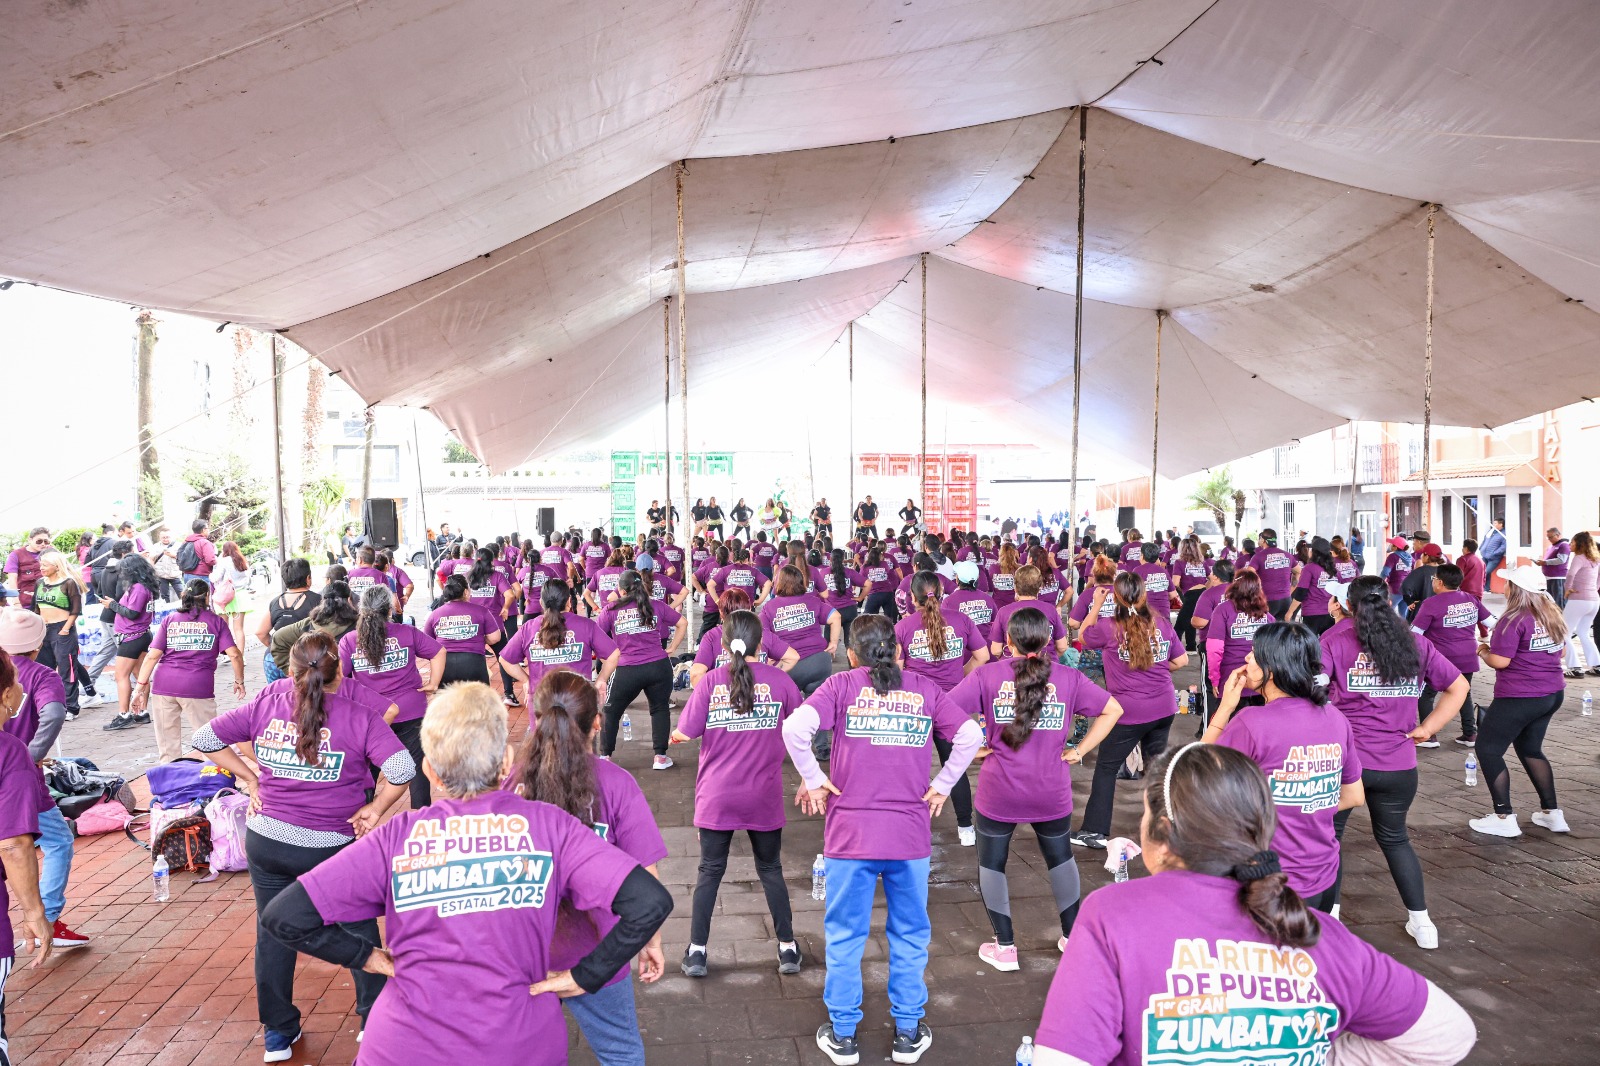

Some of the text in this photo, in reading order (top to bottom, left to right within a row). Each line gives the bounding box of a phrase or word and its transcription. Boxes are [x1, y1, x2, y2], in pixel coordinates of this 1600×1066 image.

[714, 685, 729, 694] AL
[1002, 682, 1016, 691] AL
[1398, 686, 1419, 696] 2025
[861, 688, 923, 705] AL RITMO
[1000, 692, 1014, 700] DE
[857, 699, 923, 716] DE PUEBLA
[269, 720, 284, 732] AL
[728, 718, 777, 731] ESTATAL 2025
[1039, 718, 1062, 728] 2025
[264, 730, 279, 740] DE
[872, 734, 927, 746] ESTATAL 2025
[1289, 745, 1342, 760] AL RITMO
[1285, 761, 1304, 772] DE
[273, 769, 339, 781] ESTATAL 2025
[413, 817, 526, 839] AL RITMO
[408, 835, 532, 857] DE PUEBLA
[410, 854, 446, 870] GRAN
[441, 886, 545, 913] ESTATAL 2025
[1177, 944, 1314, 978] AL RITMO
[1171, 973, 1322, 1004] DE PUEBLA
[1176, 996, 1225, 1016] GRAN
